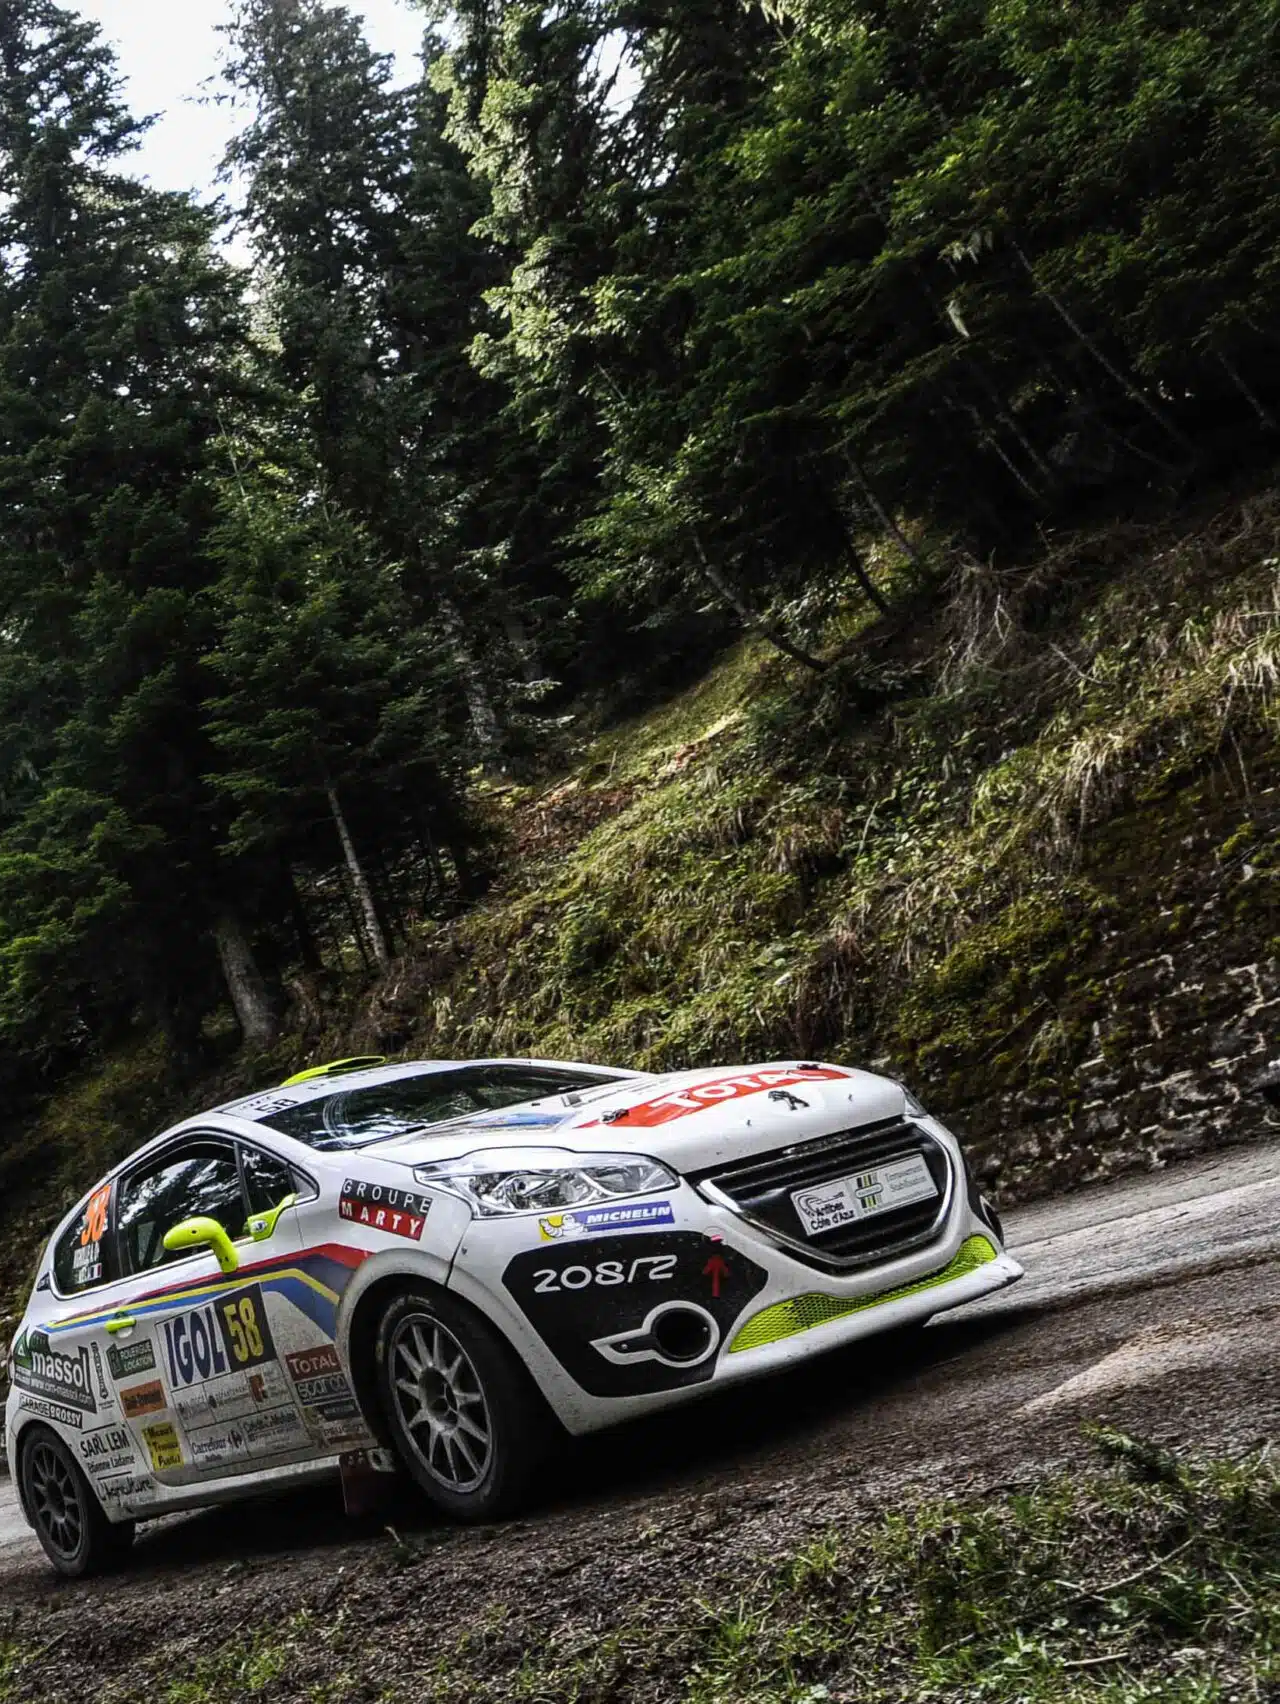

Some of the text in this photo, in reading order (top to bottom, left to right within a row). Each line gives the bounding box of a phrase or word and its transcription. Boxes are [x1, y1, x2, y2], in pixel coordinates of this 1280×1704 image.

[650, 1068, 830, 1110] TOTAL
[342, 1179, 432, 1214] GROUPE
[81, 1184, 112, 1247] 58
[340, 1200, 421, 1236] MARTY
[586, 1206, 670, 1225] MICHELIN
[163, 1306, 226, 1388] IGOL
[223, 1297, 264, 1362] 58
[30, 1350, 90, 1394] massol
[288, 1353, 338, 1375] TOTAL
[80, 1433, 108, 1458] SARL
[105, 1429, 130, 1452] LEM
